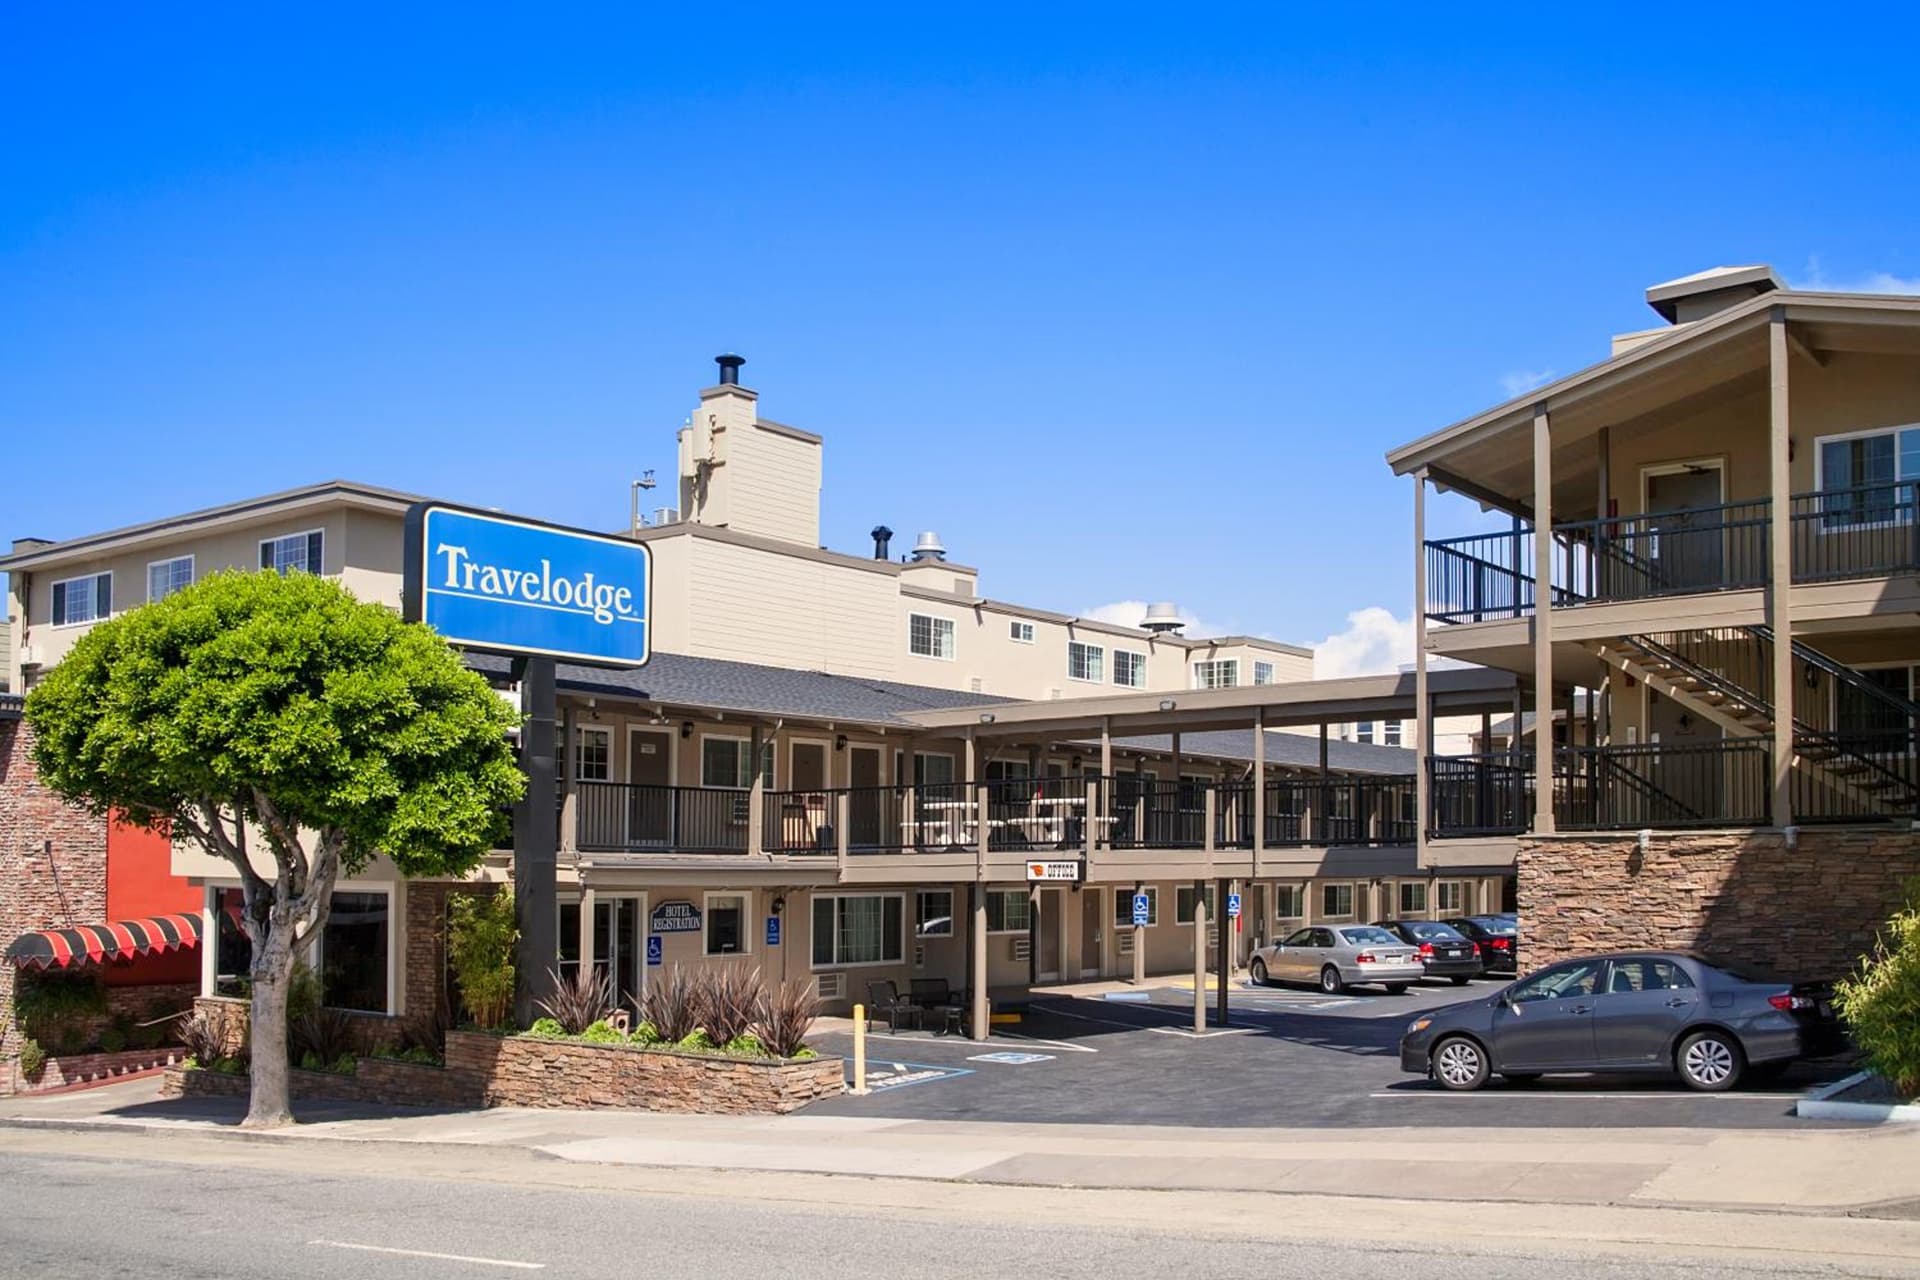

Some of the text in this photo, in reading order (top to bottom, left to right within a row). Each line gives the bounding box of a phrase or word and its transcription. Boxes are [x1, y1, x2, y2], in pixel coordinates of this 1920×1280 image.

[437, 543, 632, 624] Travelodge
[1048, 864, 1074, 878] OFFICE
[665, 905, 691, 917] HOTEL
[653, 917, 700, 929] REGISTRATION
